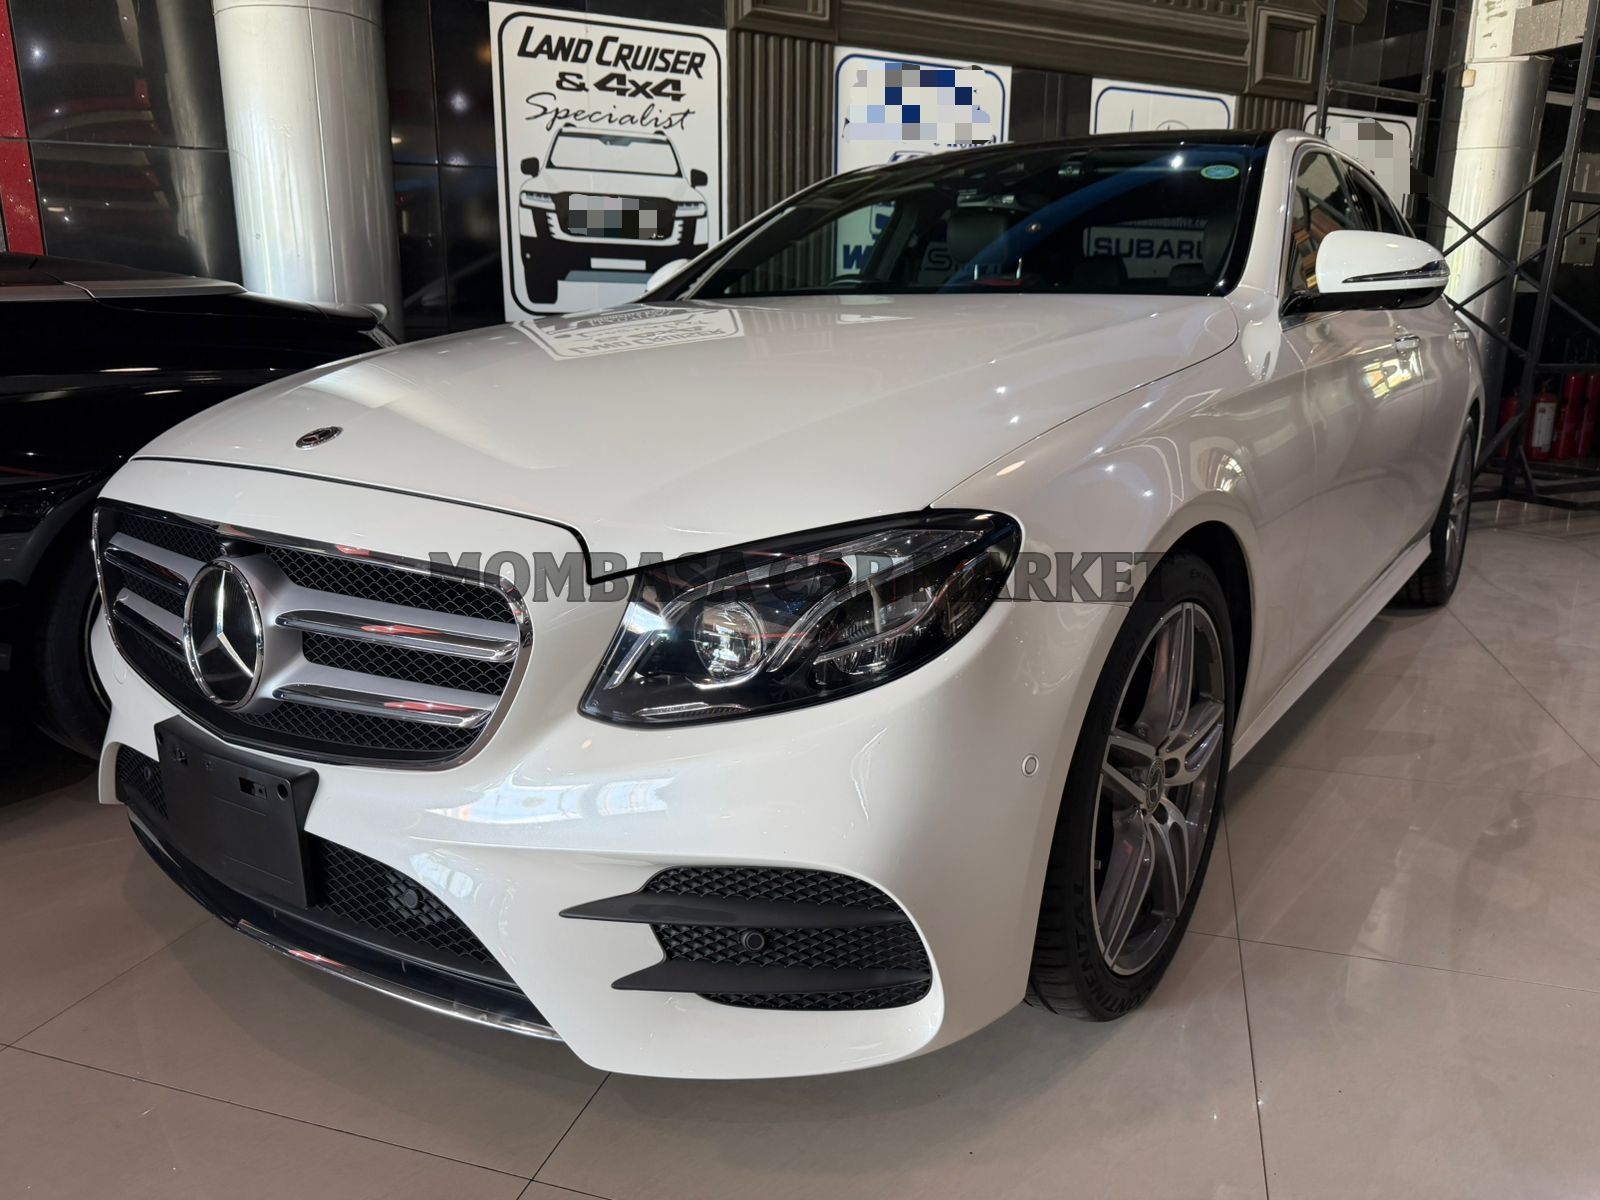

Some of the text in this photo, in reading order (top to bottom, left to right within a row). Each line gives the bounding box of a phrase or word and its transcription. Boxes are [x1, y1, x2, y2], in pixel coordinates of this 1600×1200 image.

[518, 26, 706, 79] LAND CRUISER
[556, 72, 589, 92] &
[525, 92, 696, 131] Specialist
